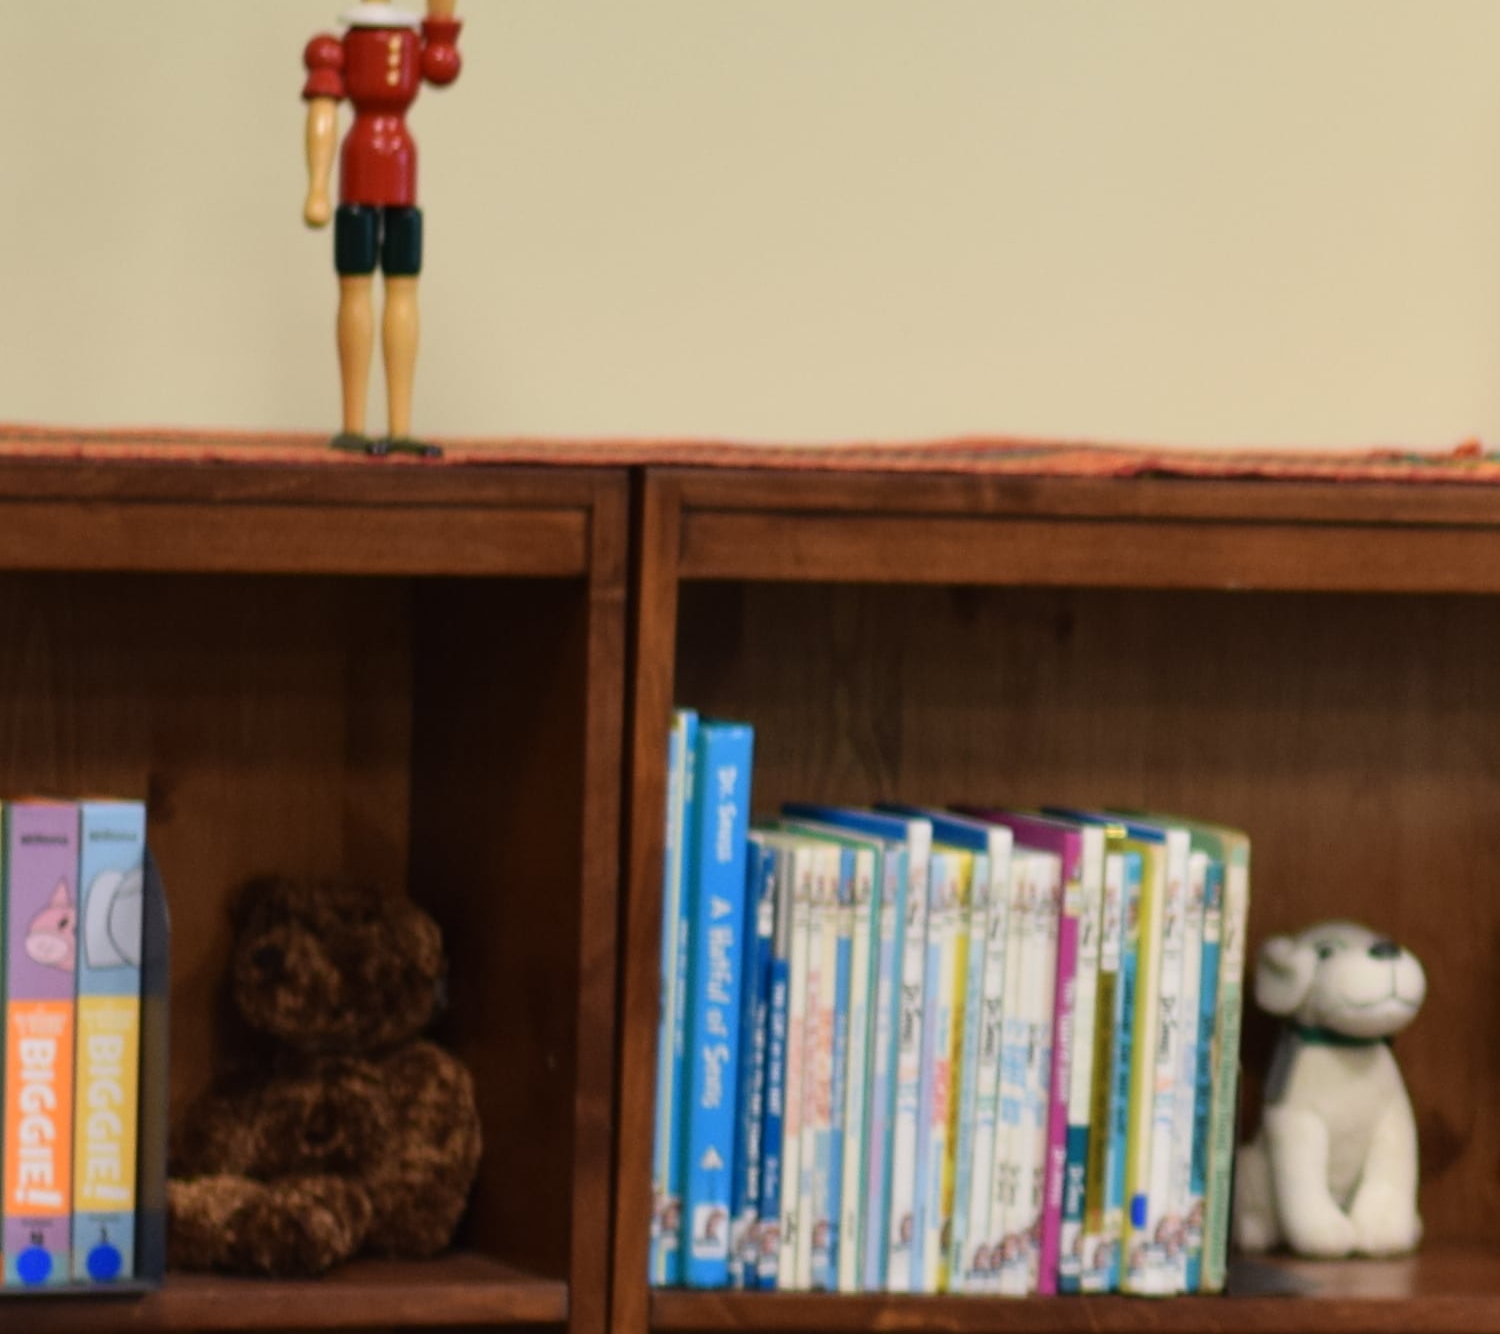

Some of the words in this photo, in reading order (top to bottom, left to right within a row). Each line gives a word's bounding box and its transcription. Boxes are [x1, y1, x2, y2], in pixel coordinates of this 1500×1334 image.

[716, 765, 738, 799] Dr.
[713, 801, 736, 861] Seuss
[709, 895, 734, 918] A
[705, 923, 733, 1002] Hatful
[703, 1005, 729, 1035] of
[700, 1043, 727, 1108] Seuss
[14, 1038, 63, 1207] BIGGIE!
[84, 1034, 131, 1201] BIGGIE!
